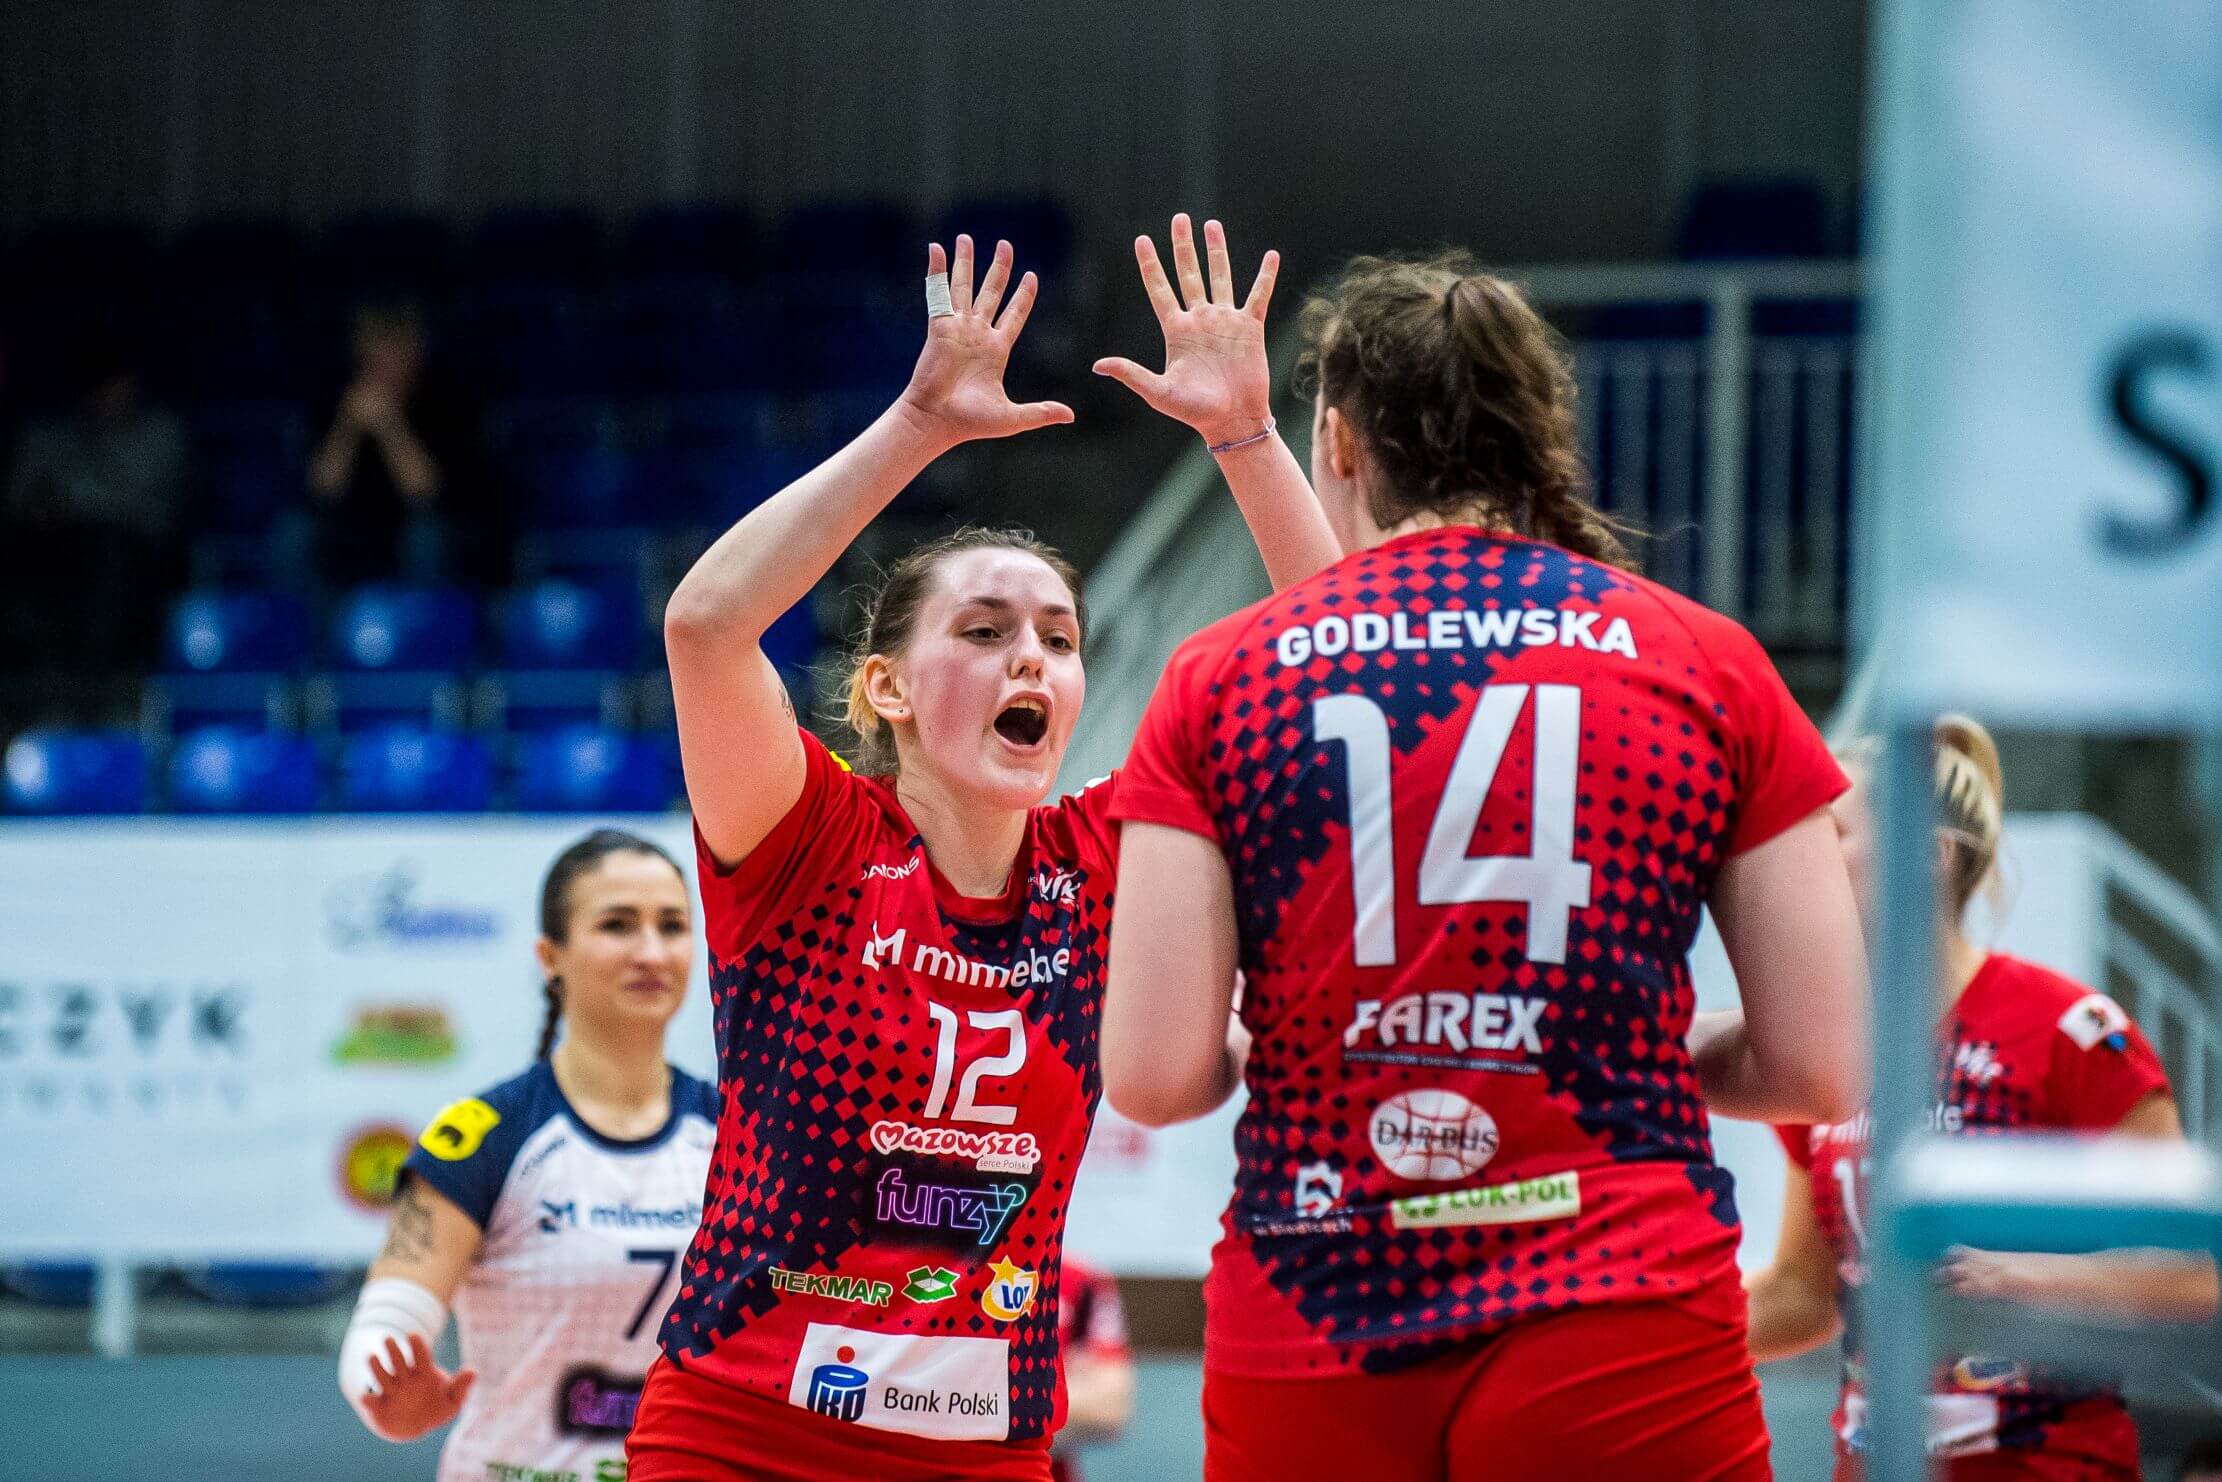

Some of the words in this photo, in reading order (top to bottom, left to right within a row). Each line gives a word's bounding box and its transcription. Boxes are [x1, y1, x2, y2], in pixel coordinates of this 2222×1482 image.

[1277, 608, 1639, 667] GODLEWSKA
[1313, 683, 1592, 967] 14
[1344, 990, 1549, 1055] FAREX
[923, 1000, 1027, 1126] 12
[978, 1159, 1001, 1168] serce
[1003, 1160, 1030, 1170] Polski
[624, 1248, 677, 1341] 7
[768, 1266, 894, 1307] TEKMAR
[884, 1386, 941, 1414] Bank
[948, 1391, 999, 1416] Polski
